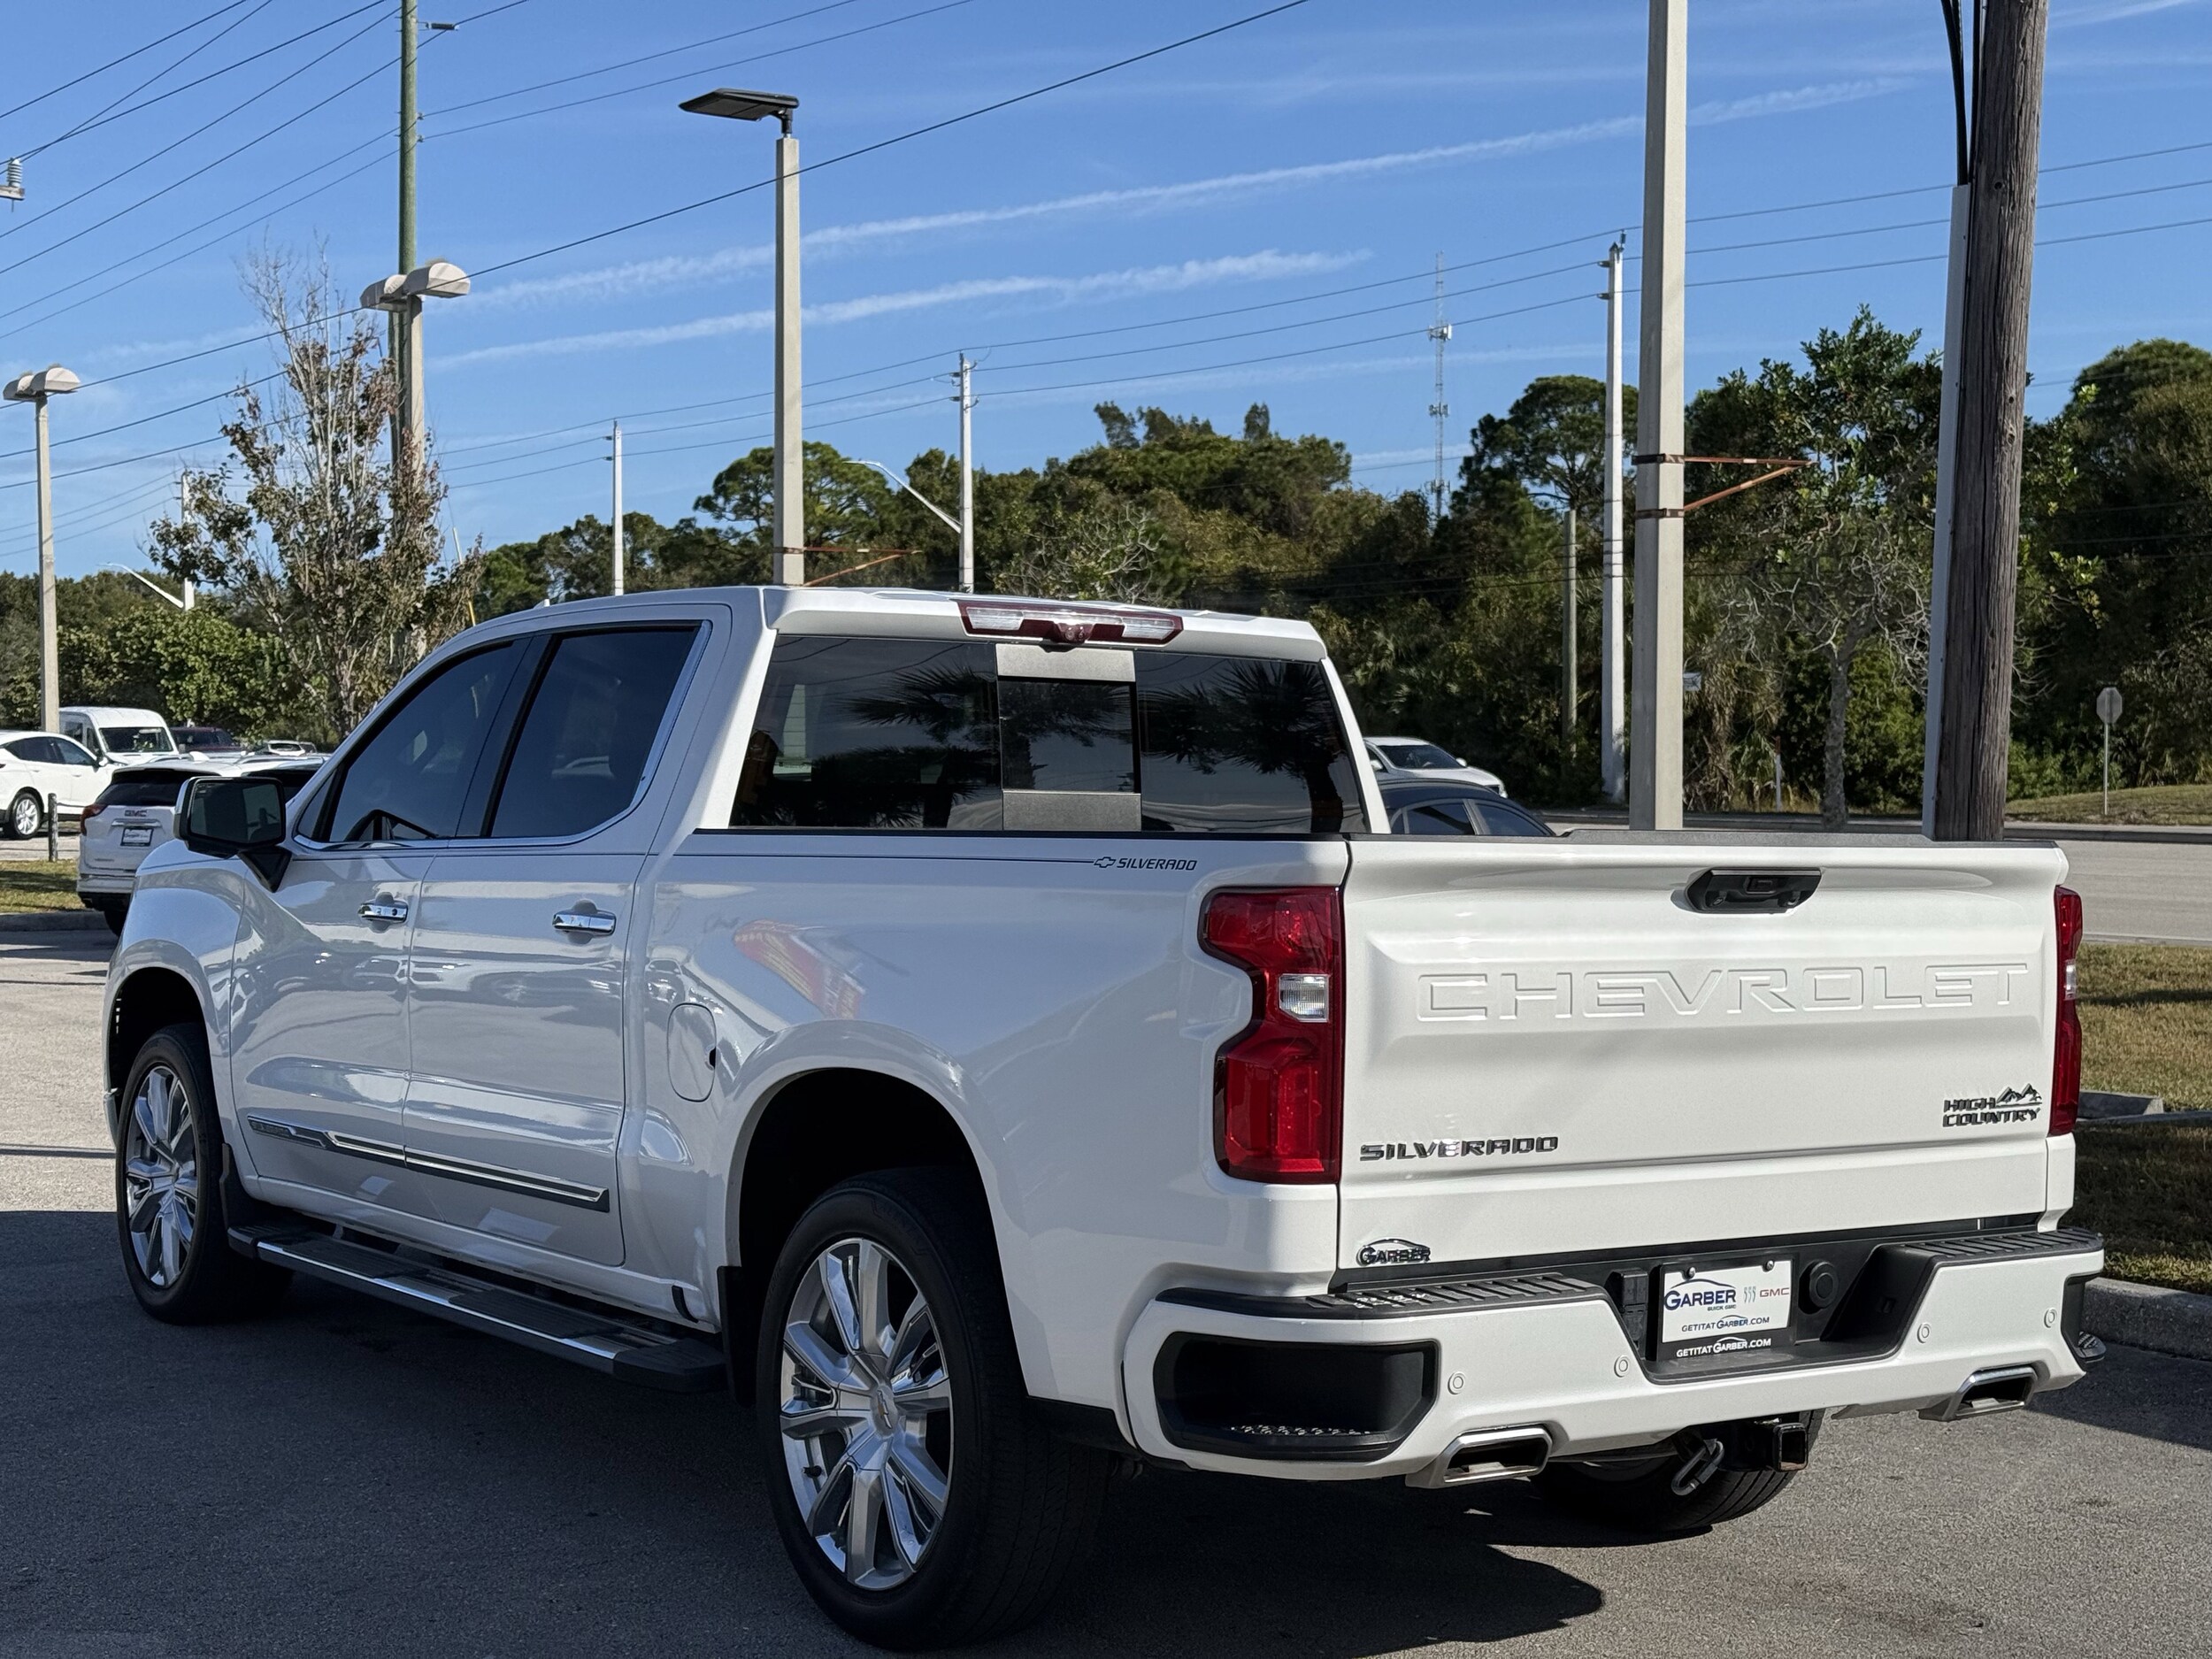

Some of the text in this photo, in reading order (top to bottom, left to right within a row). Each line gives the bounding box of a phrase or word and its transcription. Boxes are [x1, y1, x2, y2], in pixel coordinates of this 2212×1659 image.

[1117, 857, 1198, 871] SILVERADO
[1417, 963, 2029, 1022] CHEVROLET
[1944, 1097, 1996, 1112] HIGH
[1942, 1108, 2040, 1127] COUNTRY
[1360, 1137, 1559, 1161] SILVERADO
[1356, 1246, 1431, 1266] GARBER
[1663, 1289, 1736, 1310] GARBER
[1760, 1287, 1789, 1298] GMC
